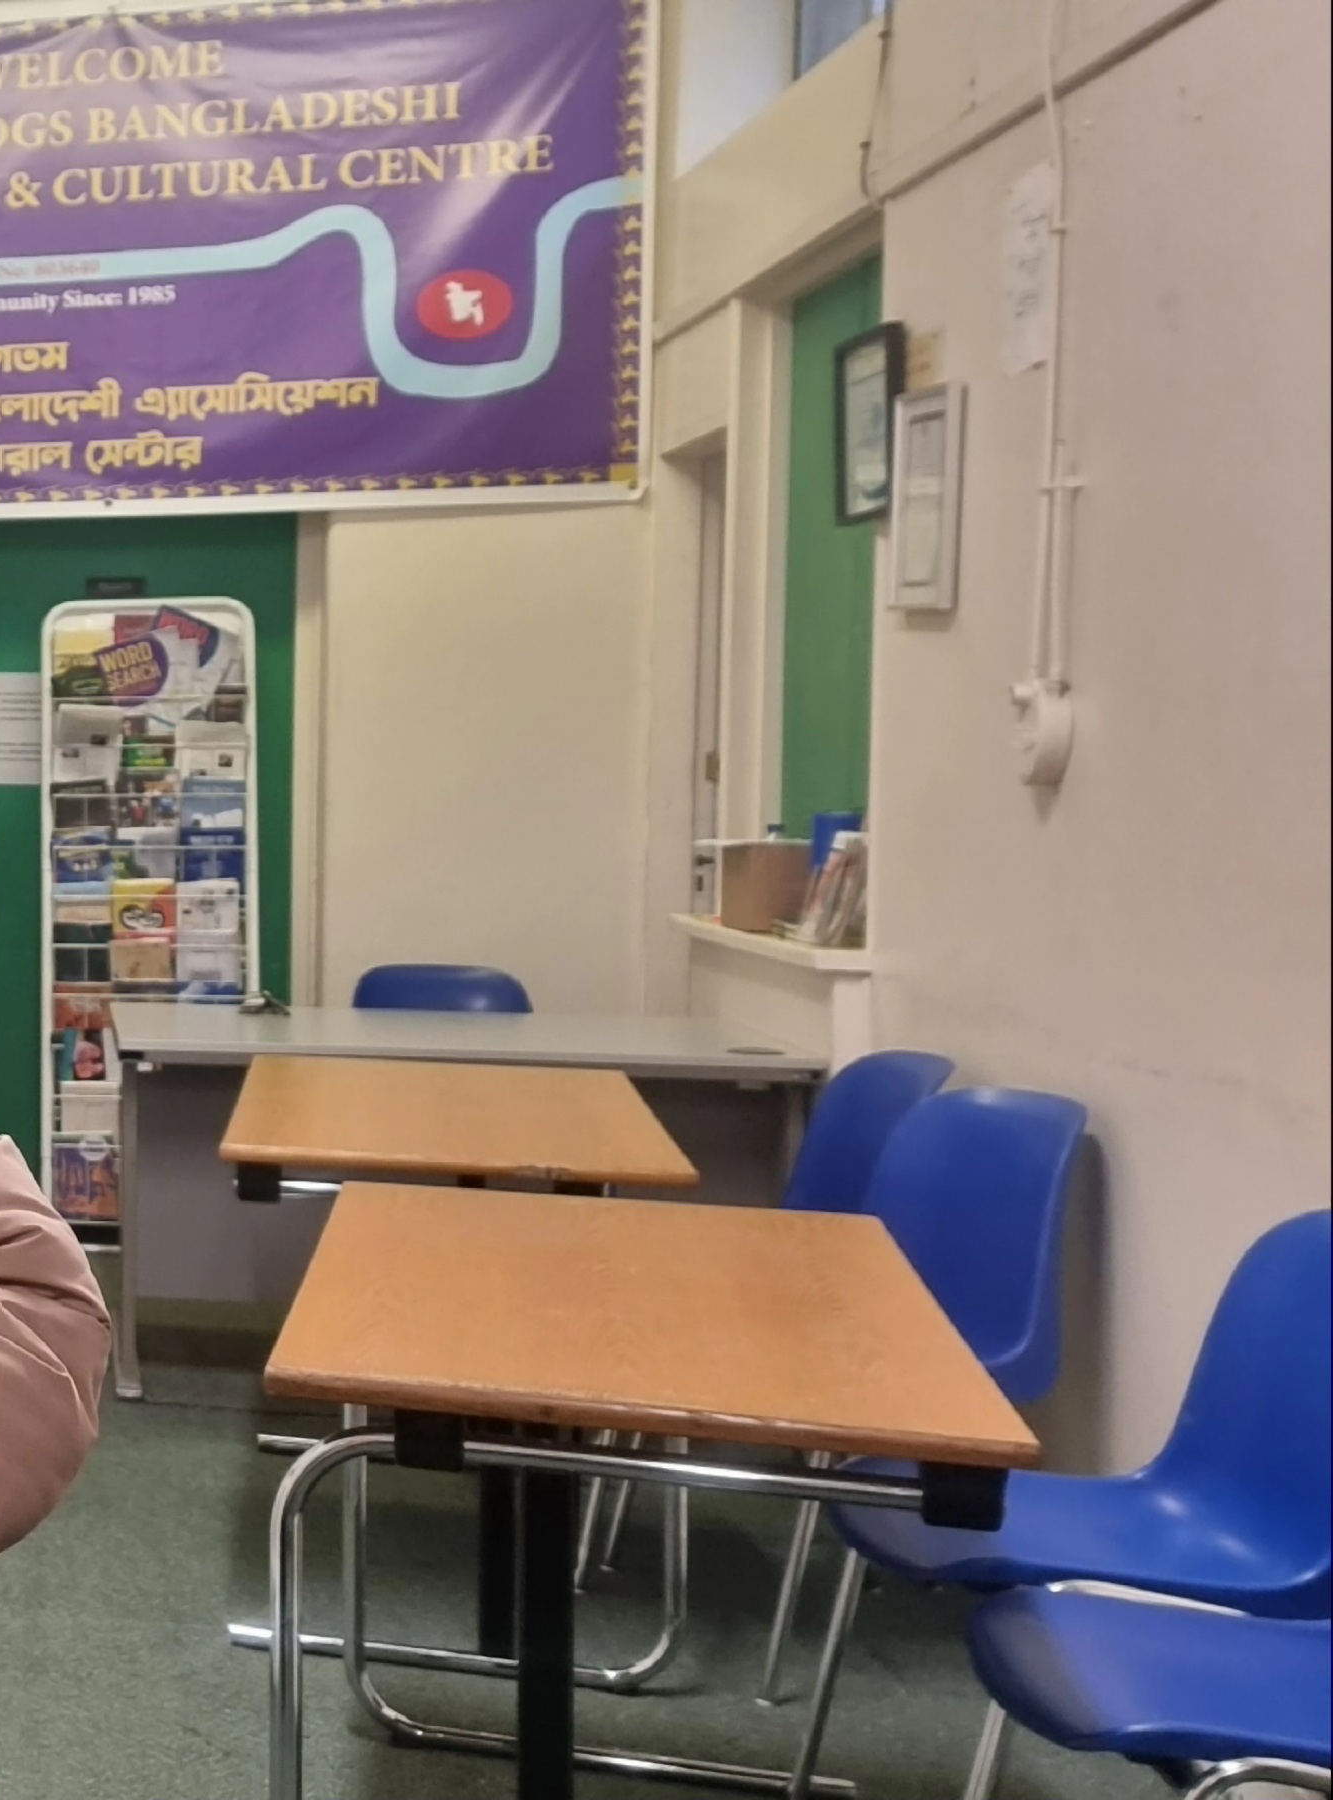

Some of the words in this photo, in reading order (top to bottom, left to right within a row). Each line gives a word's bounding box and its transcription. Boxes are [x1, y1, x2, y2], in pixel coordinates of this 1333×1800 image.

[87, 80, 462, 143] BANGLADESHI
[4, 170, 41, 209] &
[52, 153, 328, 205] CULTURAL
[338, 134, 554, 189] CENTRE
[62, 288, 124, 309] Since:
[128, 284, 177, 307] 1985
[86, 429, 204, 476] সেন্টার
[98, 640, 153, 673] WORD
[106, 660, 162, 693] SEARCH
